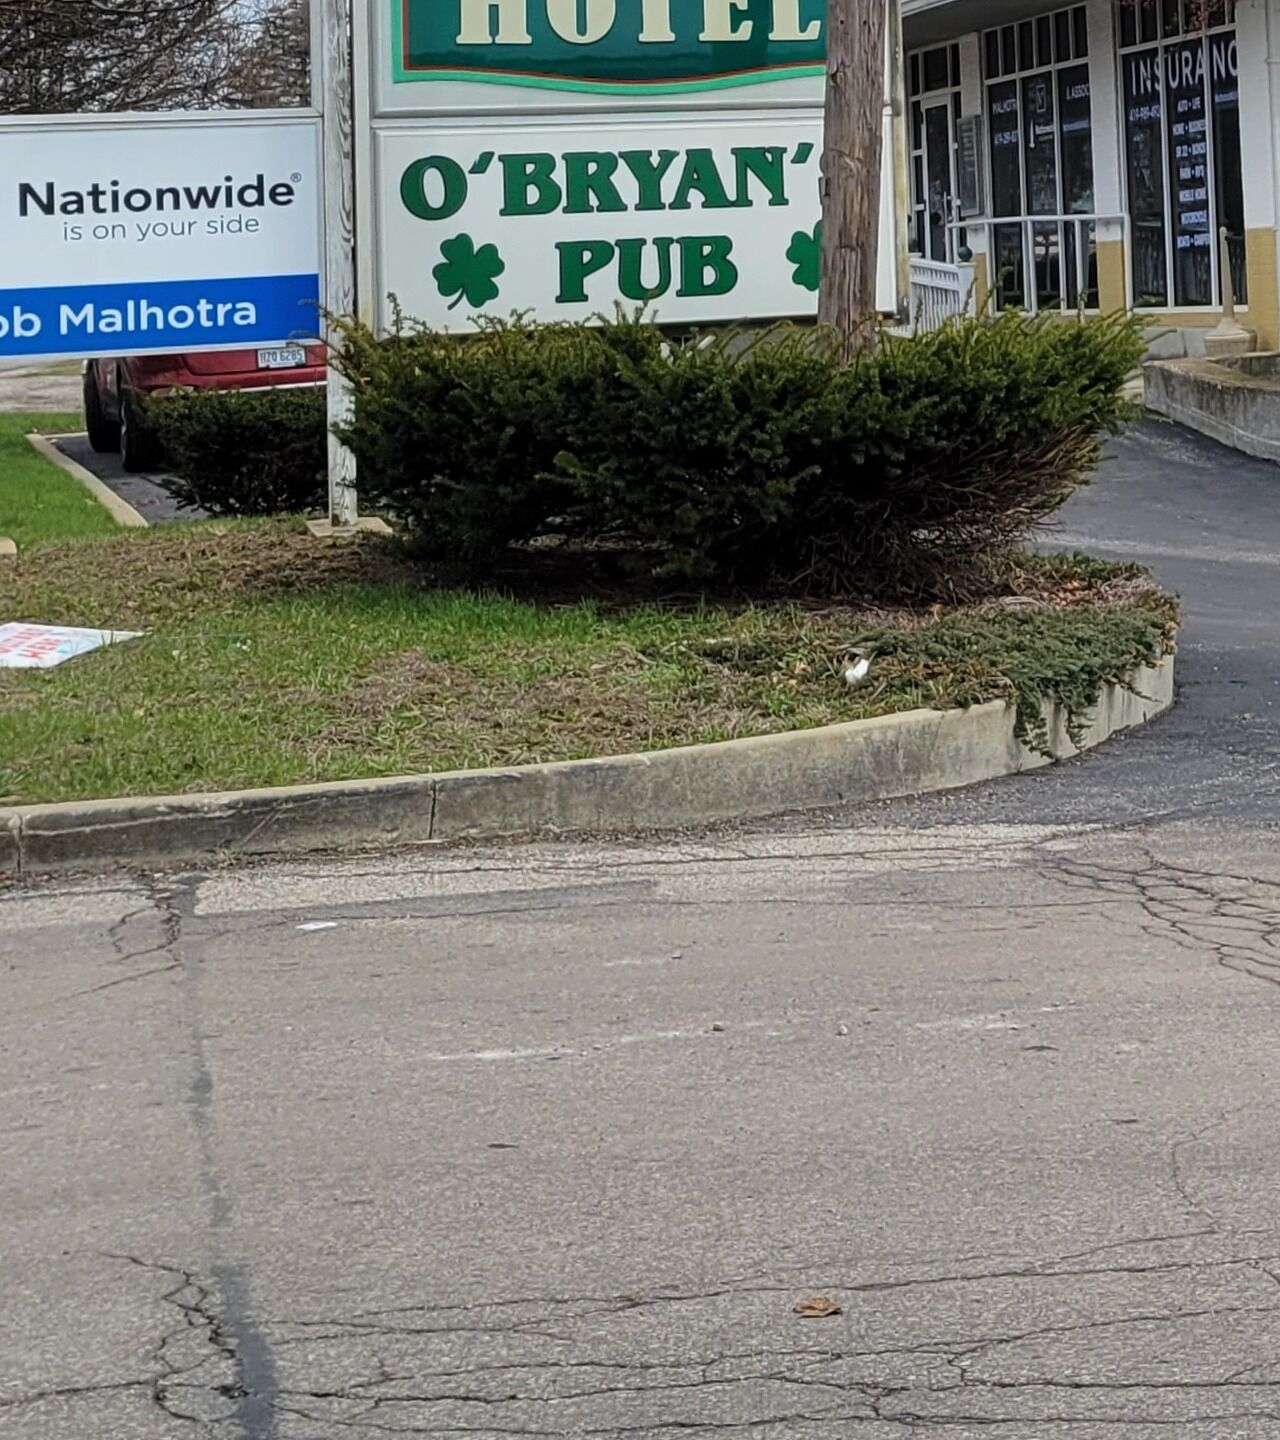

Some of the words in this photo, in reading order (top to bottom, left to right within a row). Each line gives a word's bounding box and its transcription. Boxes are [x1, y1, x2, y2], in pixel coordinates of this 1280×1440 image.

[18, 174, 296, 217] Nationwide
[400, 142, 823, 220] O'BRYAN'
[63, 222, 82, 241] is
[92, 223, 126, 240] on
[136, 219, 198, 242] your
[206, 214, 260, 235] side
[555, 235, 738, 303] PUB
[59, 298, 257, 336] Malhotra
